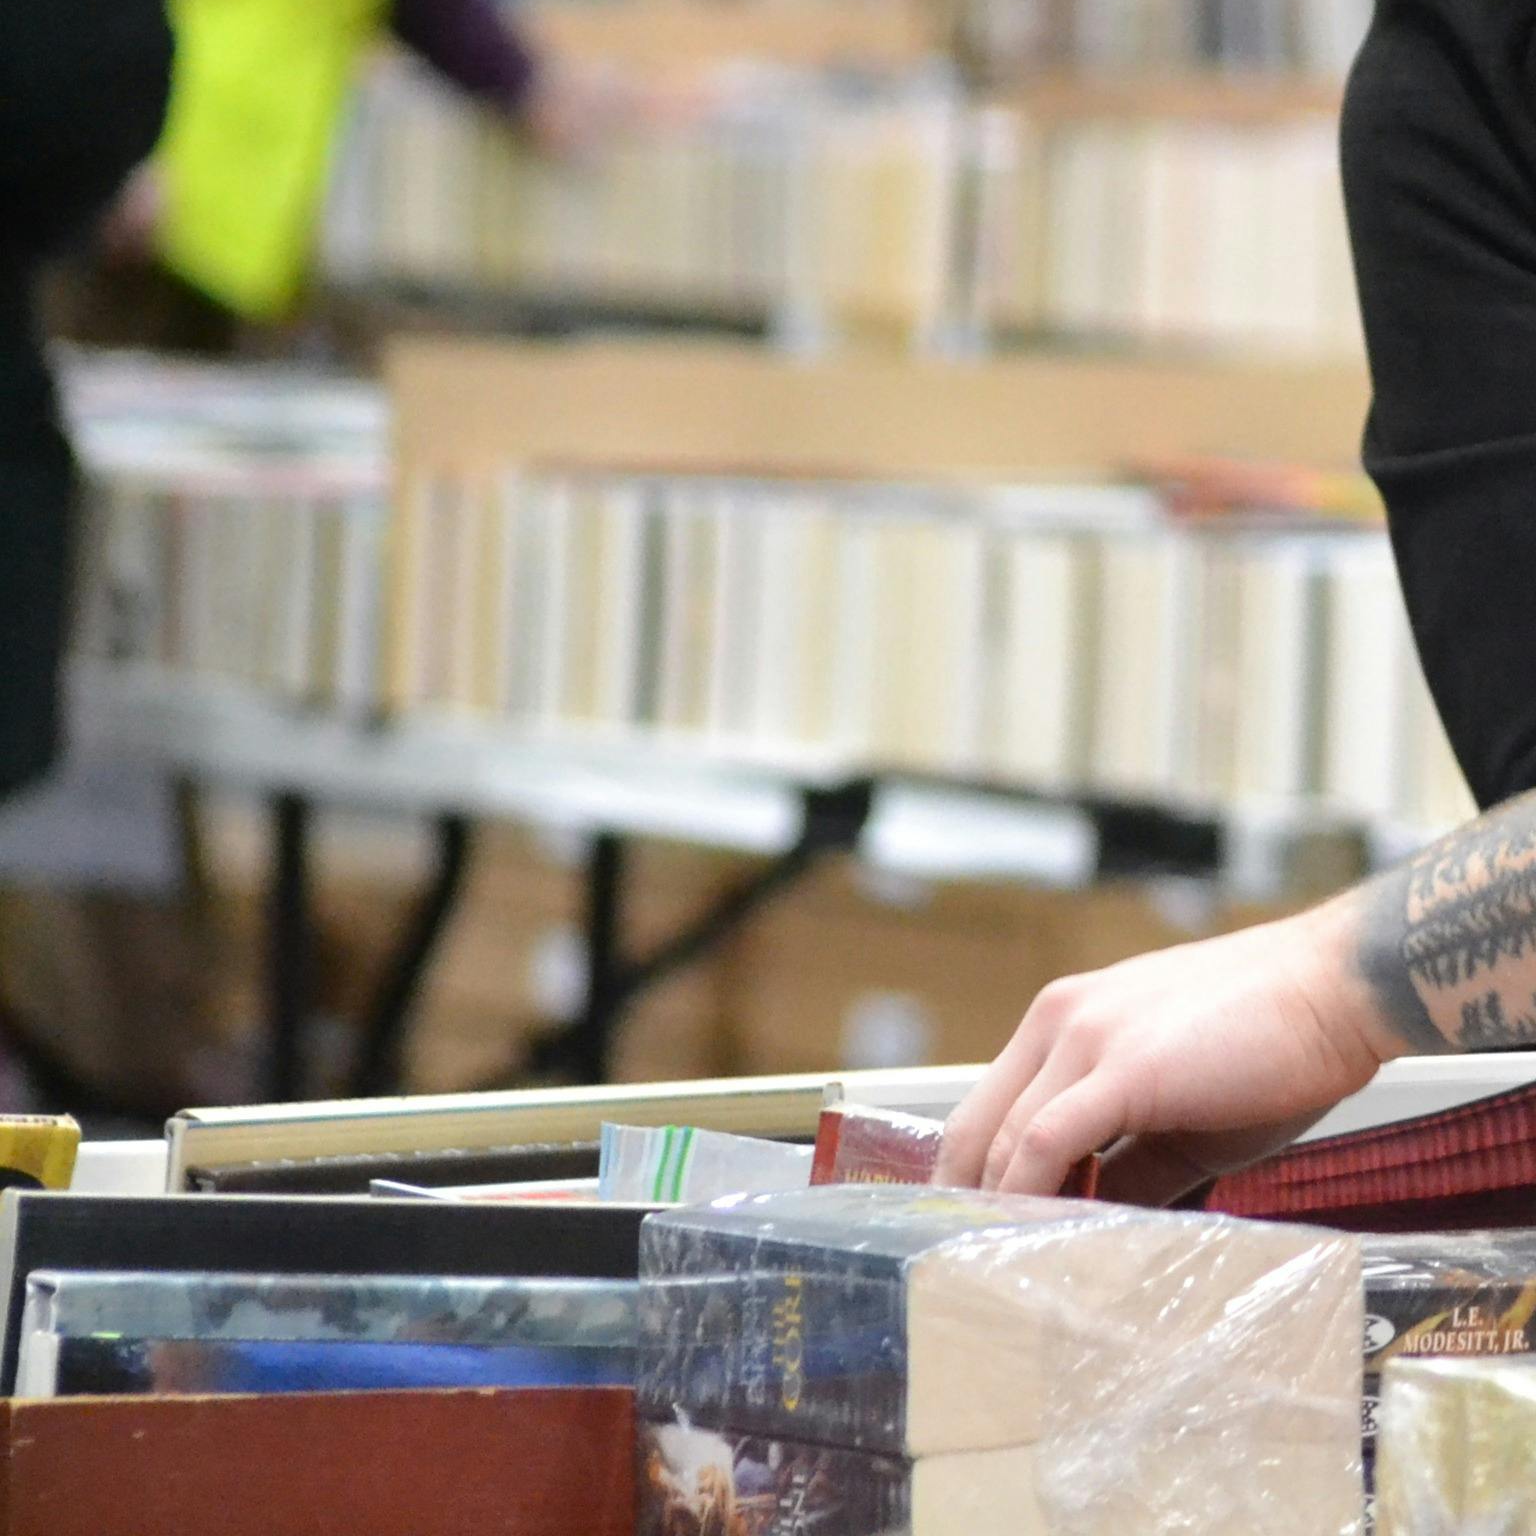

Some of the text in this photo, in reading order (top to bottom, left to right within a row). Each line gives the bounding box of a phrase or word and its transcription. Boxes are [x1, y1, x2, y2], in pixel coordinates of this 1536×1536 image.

[1453, 1306, 1484, 1327] L.E.
[784, 1264, 803, 1412] CORE
[1402, 1329, 1530, 1354] MODESITT, JR.
